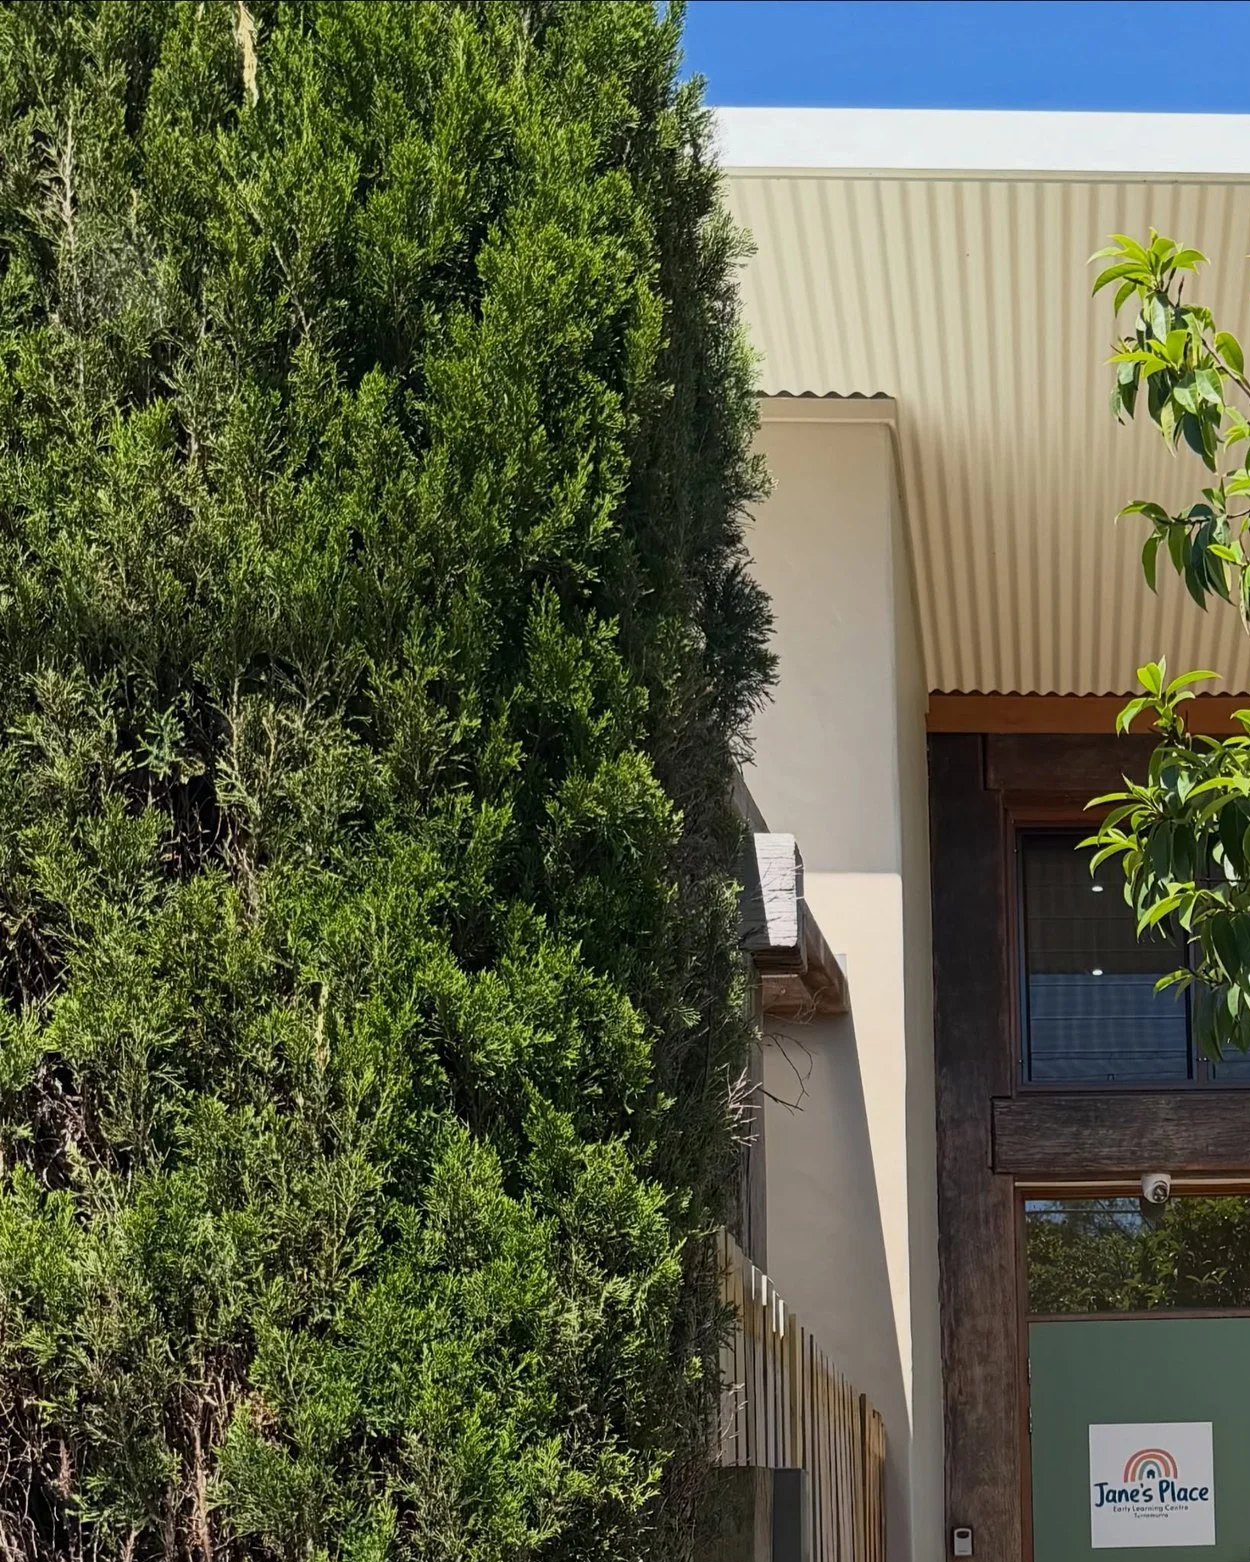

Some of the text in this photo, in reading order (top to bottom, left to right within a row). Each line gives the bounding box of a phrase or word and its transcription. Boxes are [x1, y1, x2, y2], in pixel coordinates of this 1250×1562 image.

[1093, 1479, 1209, 1508] Jane's Place
[1113, 1505, 1131, 1513] Early
[1132, 1504, 1164, 1512] Learning
